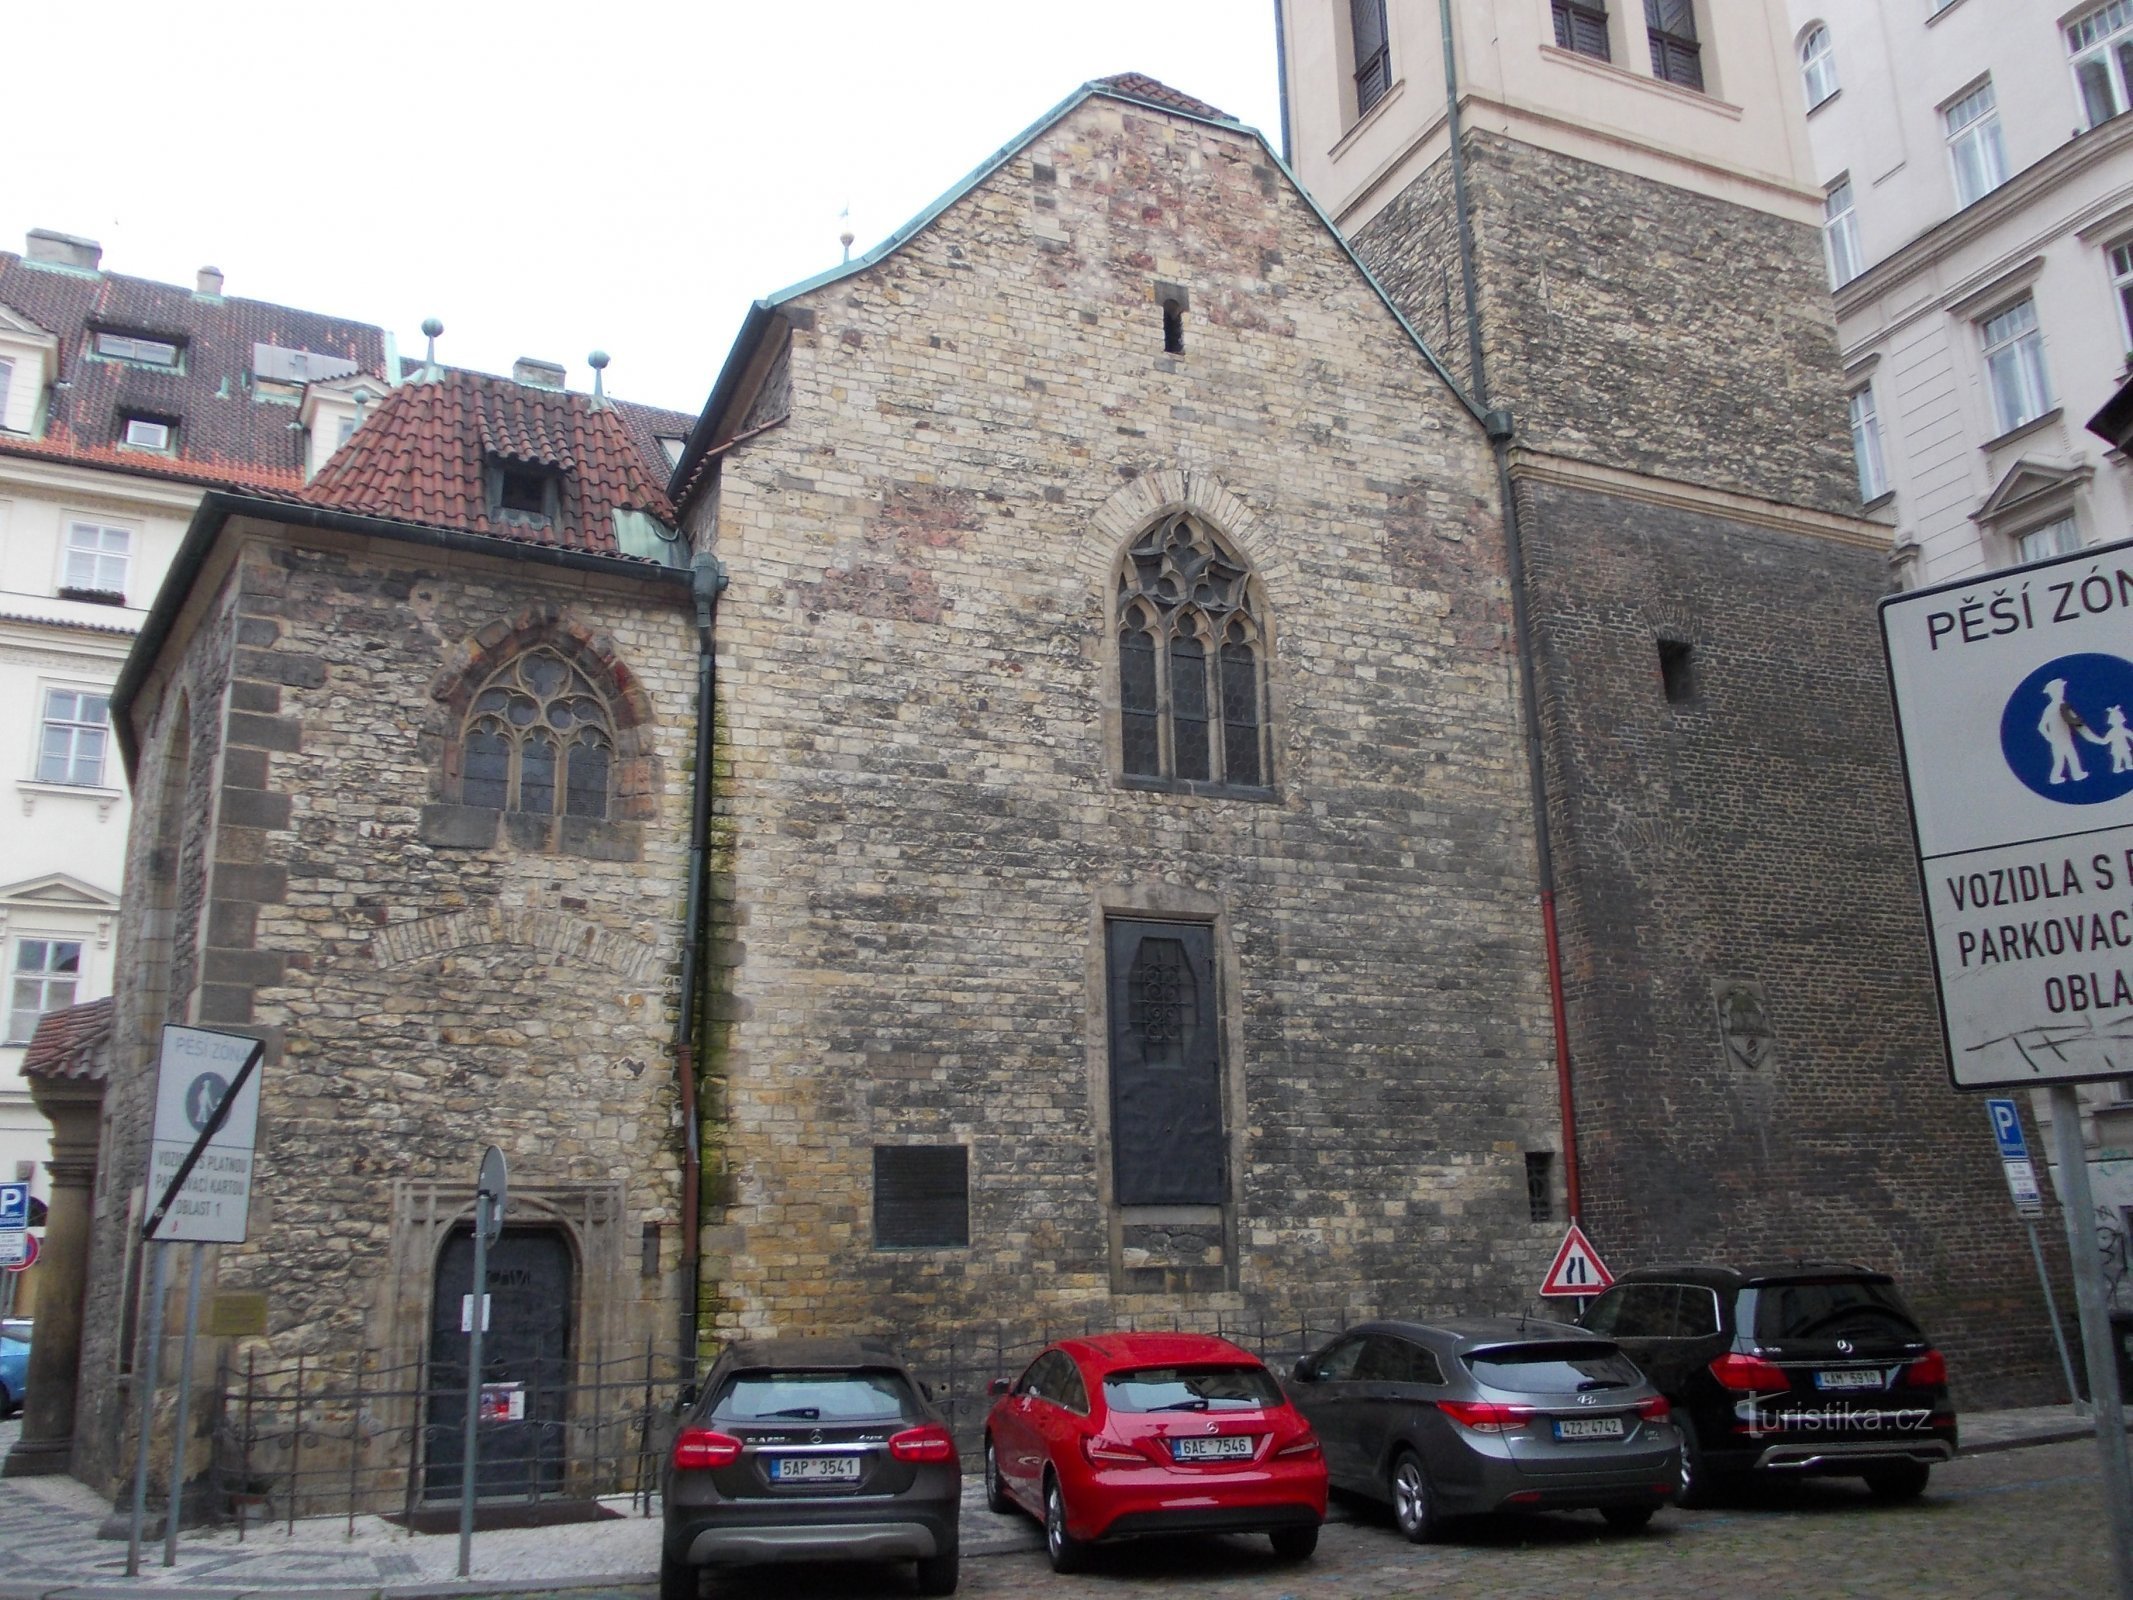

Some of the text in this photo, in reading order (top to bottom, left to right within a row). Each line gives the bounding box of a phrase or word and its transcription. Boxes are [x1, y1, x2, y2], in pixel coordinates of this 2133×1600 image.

[1927, 581, 2034, 651] PĚŠÍ
[1947, 859, 2084, 911] VOZIDLA
[2092, 854, 2114, 890] S
[1958, 905, 2133, 967] PARKOVAC
[2045, 969, 2133, 1014] OBLA
[1995, 1106, 2013, 1140] P
[207, 1155, 247, 1173] PLATNOU
[0, 1188, 21, 1215] P
[175, 1199, 211, 1215] OBLAST
[1183, 1439, 1247, 1454] 6AE 7546
[783, 1460, 853, 1475] 5AP 3541
